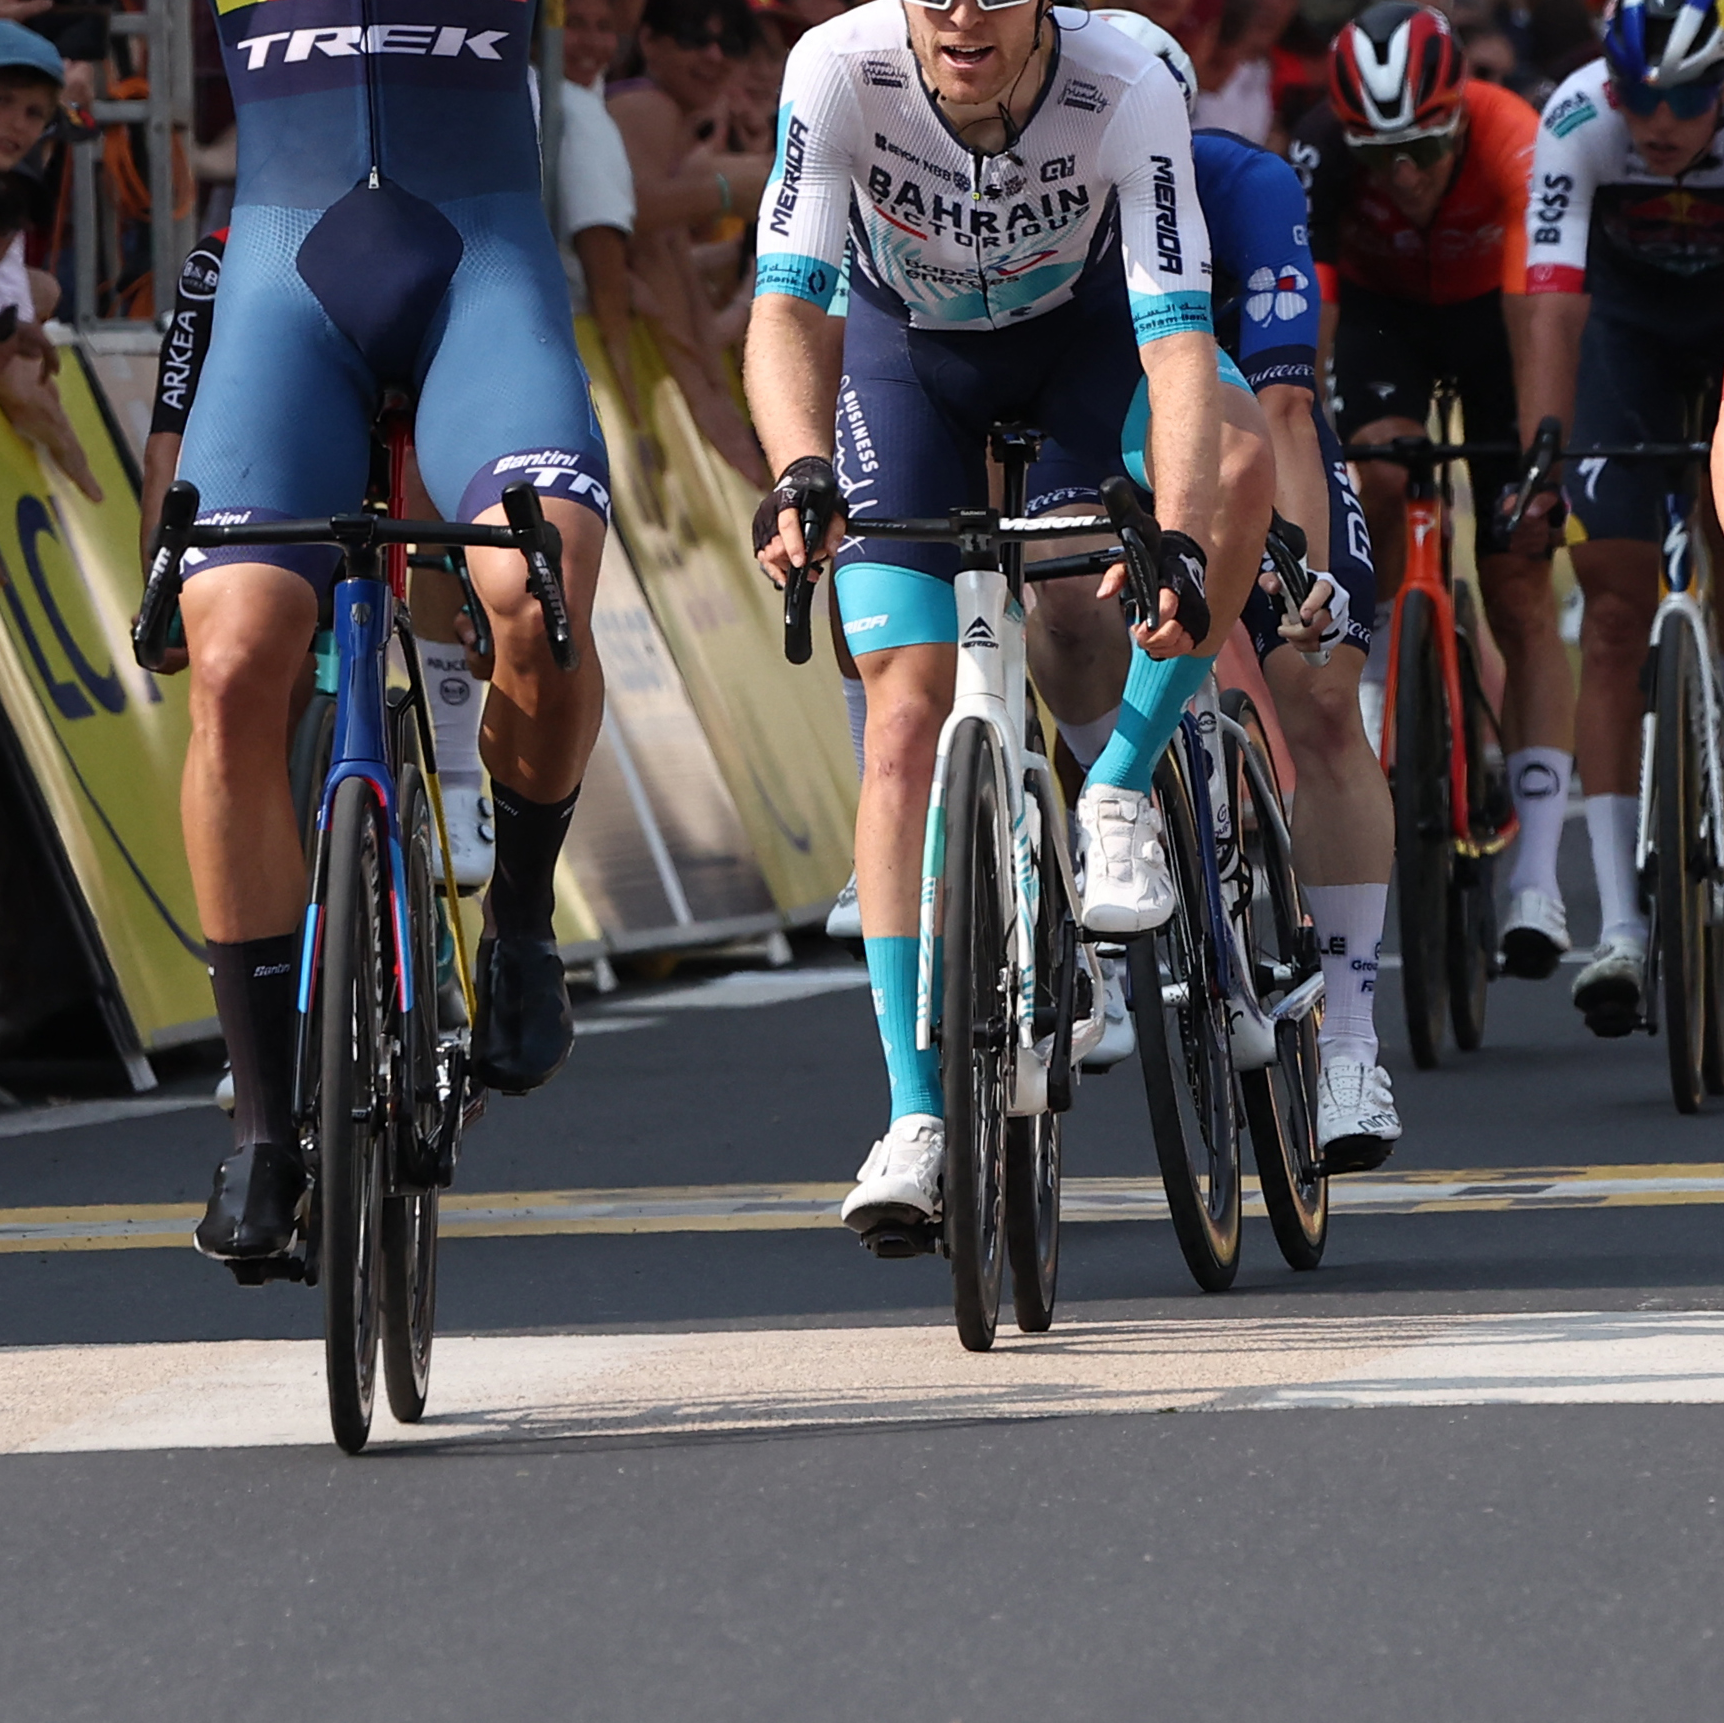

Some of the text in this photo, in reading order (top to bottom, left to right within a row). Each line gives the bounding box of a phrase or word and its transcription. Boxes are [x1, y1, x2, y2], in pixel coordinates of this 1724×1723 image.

[237, 24, 510, 71] TREK
[769, 115, 809, 237] MERIDA
[868, 164, 1092, 237] BAHRAIN
[1534, 173, 1573, 246] BOSS
[1149, 154, 1184, 276] MERIDA
[161, 309, 198, 410] ARKEA
[492, 450, 581, 476] Santini
[842, 389, 879, 474] BUSINESS
[524, 466, 612, 525] TR
